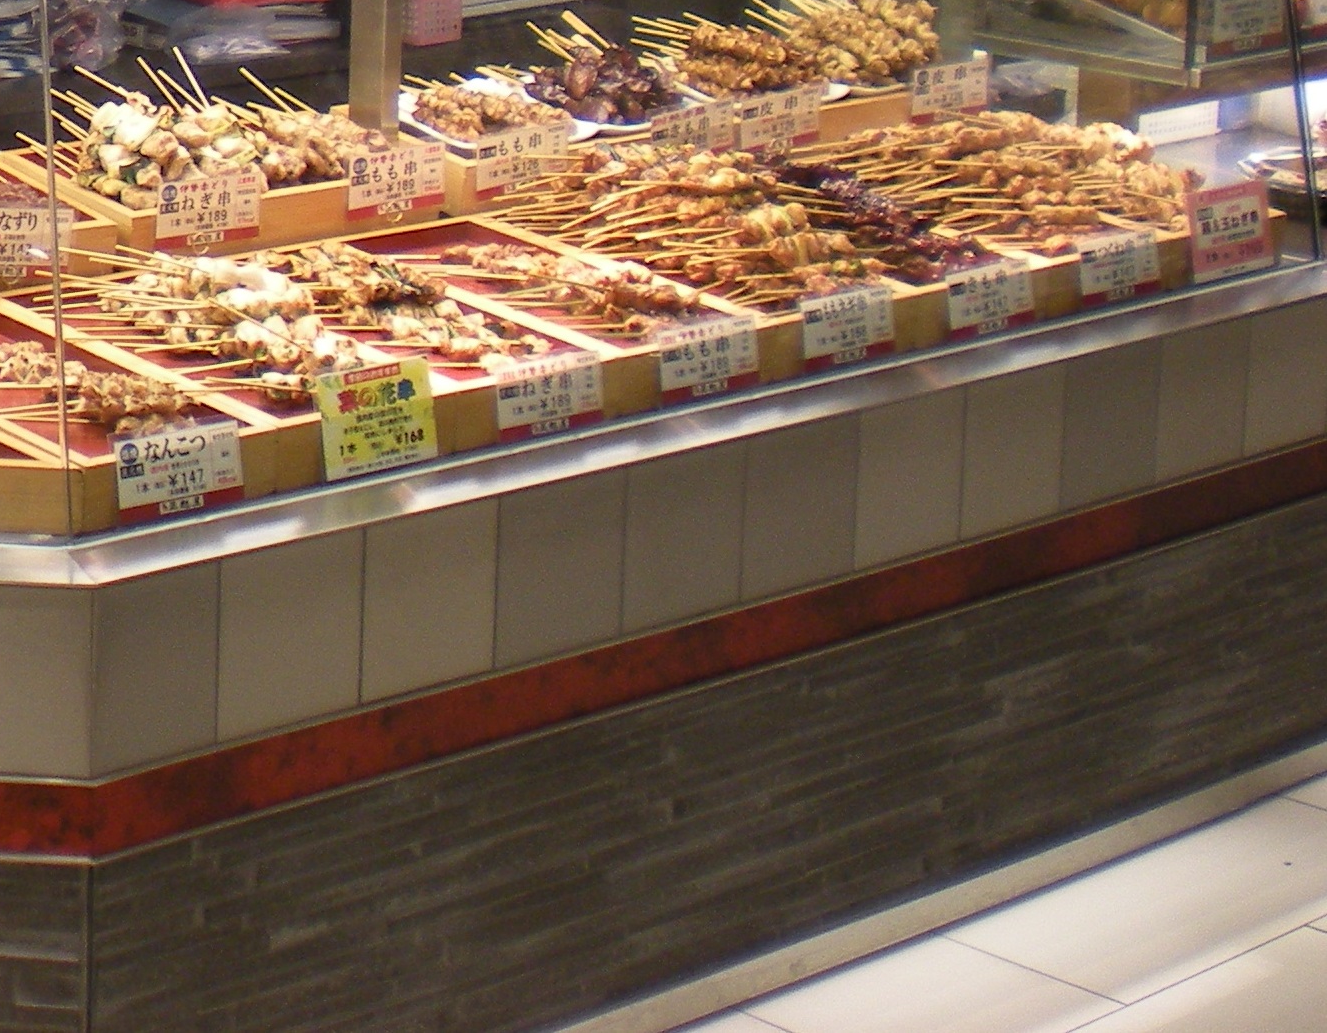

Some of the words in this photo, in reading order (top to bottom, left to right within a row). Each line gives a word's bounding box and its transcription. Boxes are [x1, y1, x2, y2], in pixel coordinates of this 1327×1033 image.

[498, 132, 541, 156] もも串
[372, 160, 417, 183] もも串
[181, 190, 231, 211] ねぎ串
[197, 209, 228, 223] ¥189
[683, 336, 730, 361] もも串
[144, 435, 206, 463] なんこつ
[168, 468, 204, 487] ¥147
